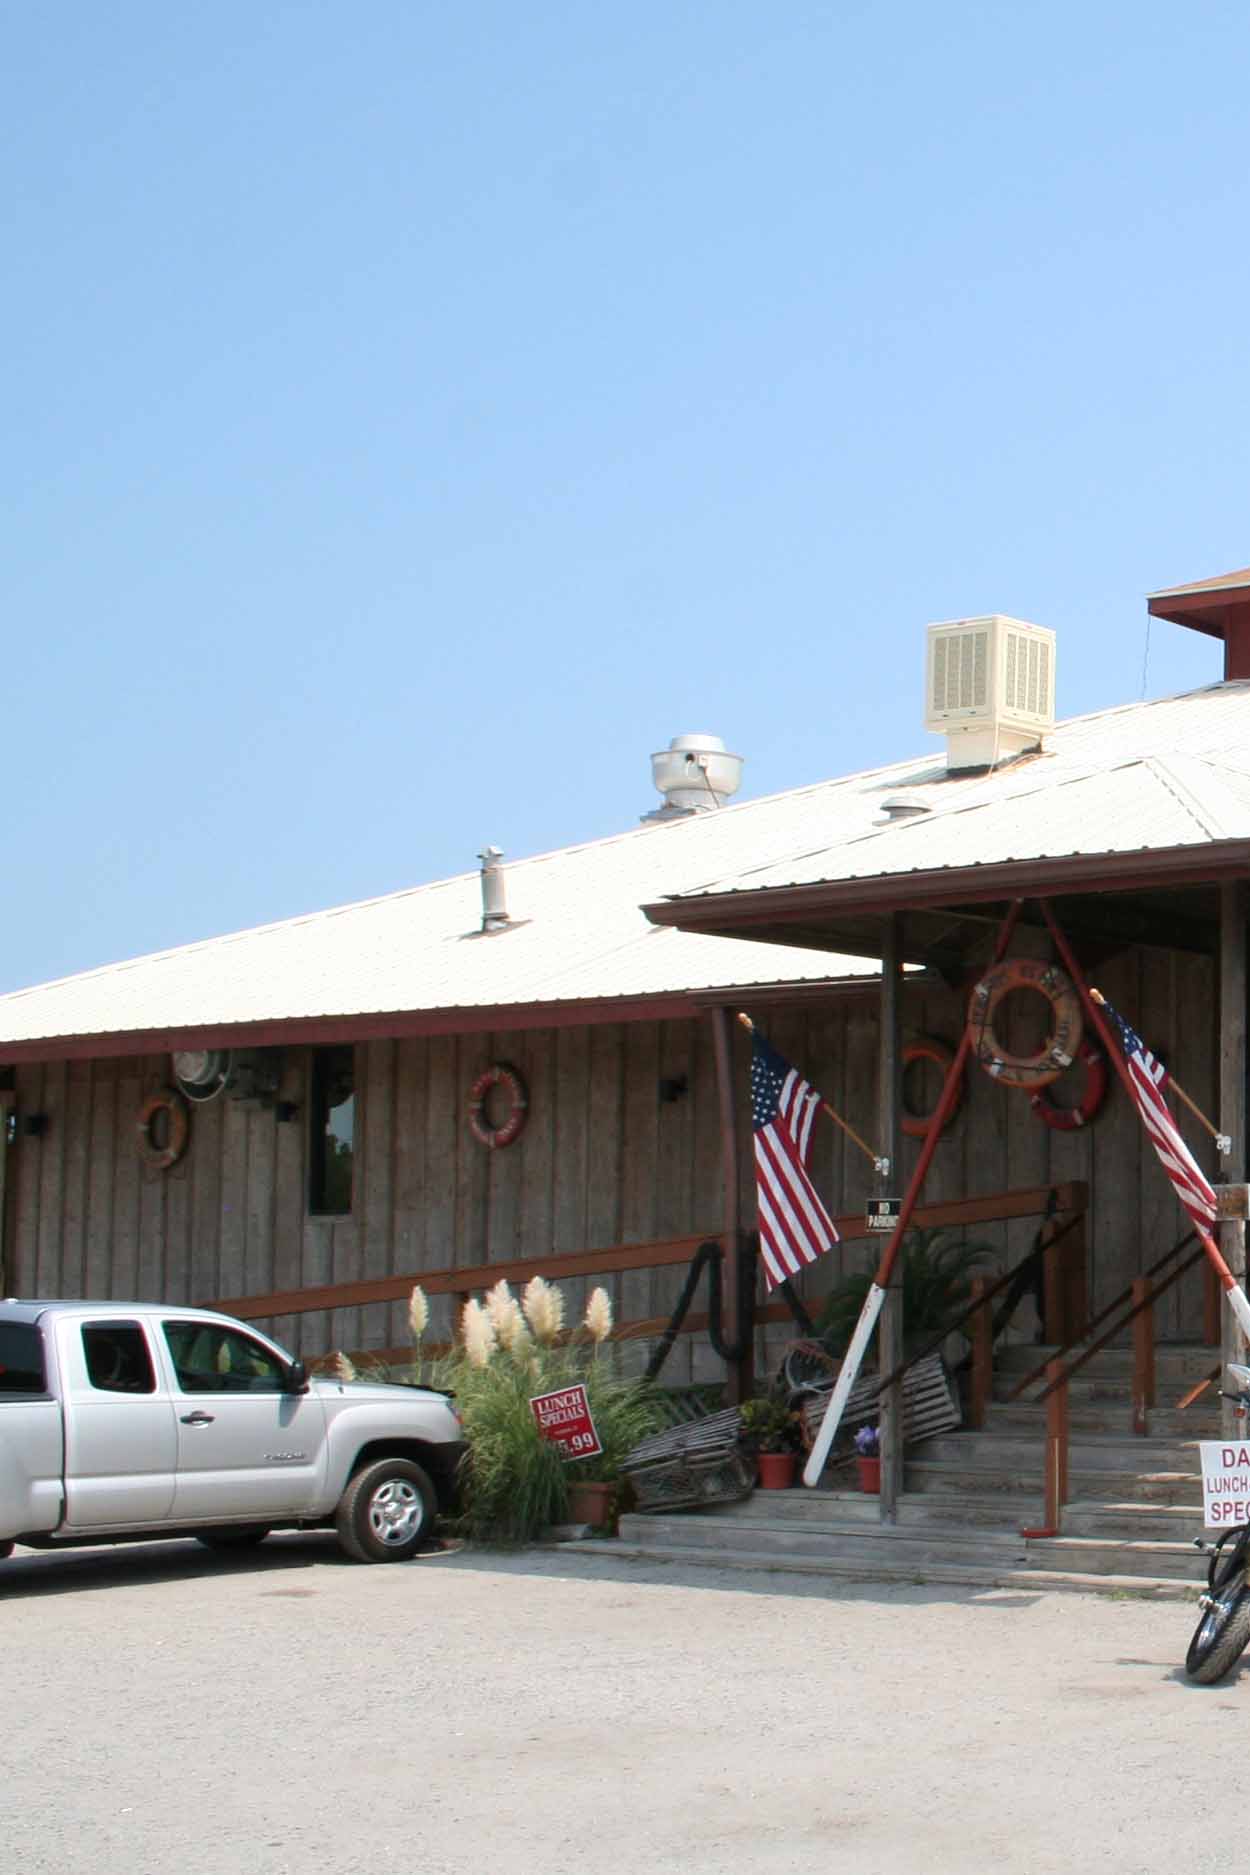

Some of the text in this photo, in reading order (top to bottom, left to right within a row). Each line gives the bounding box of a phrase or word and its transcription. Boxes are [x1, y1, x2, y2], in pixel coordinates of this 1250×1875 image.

[536, 1390, 582, 1414] LUNCH
[539, 1404, 586, 1428] SPECIALS
[1207, 1475, 1248, 1494] LUNCH
